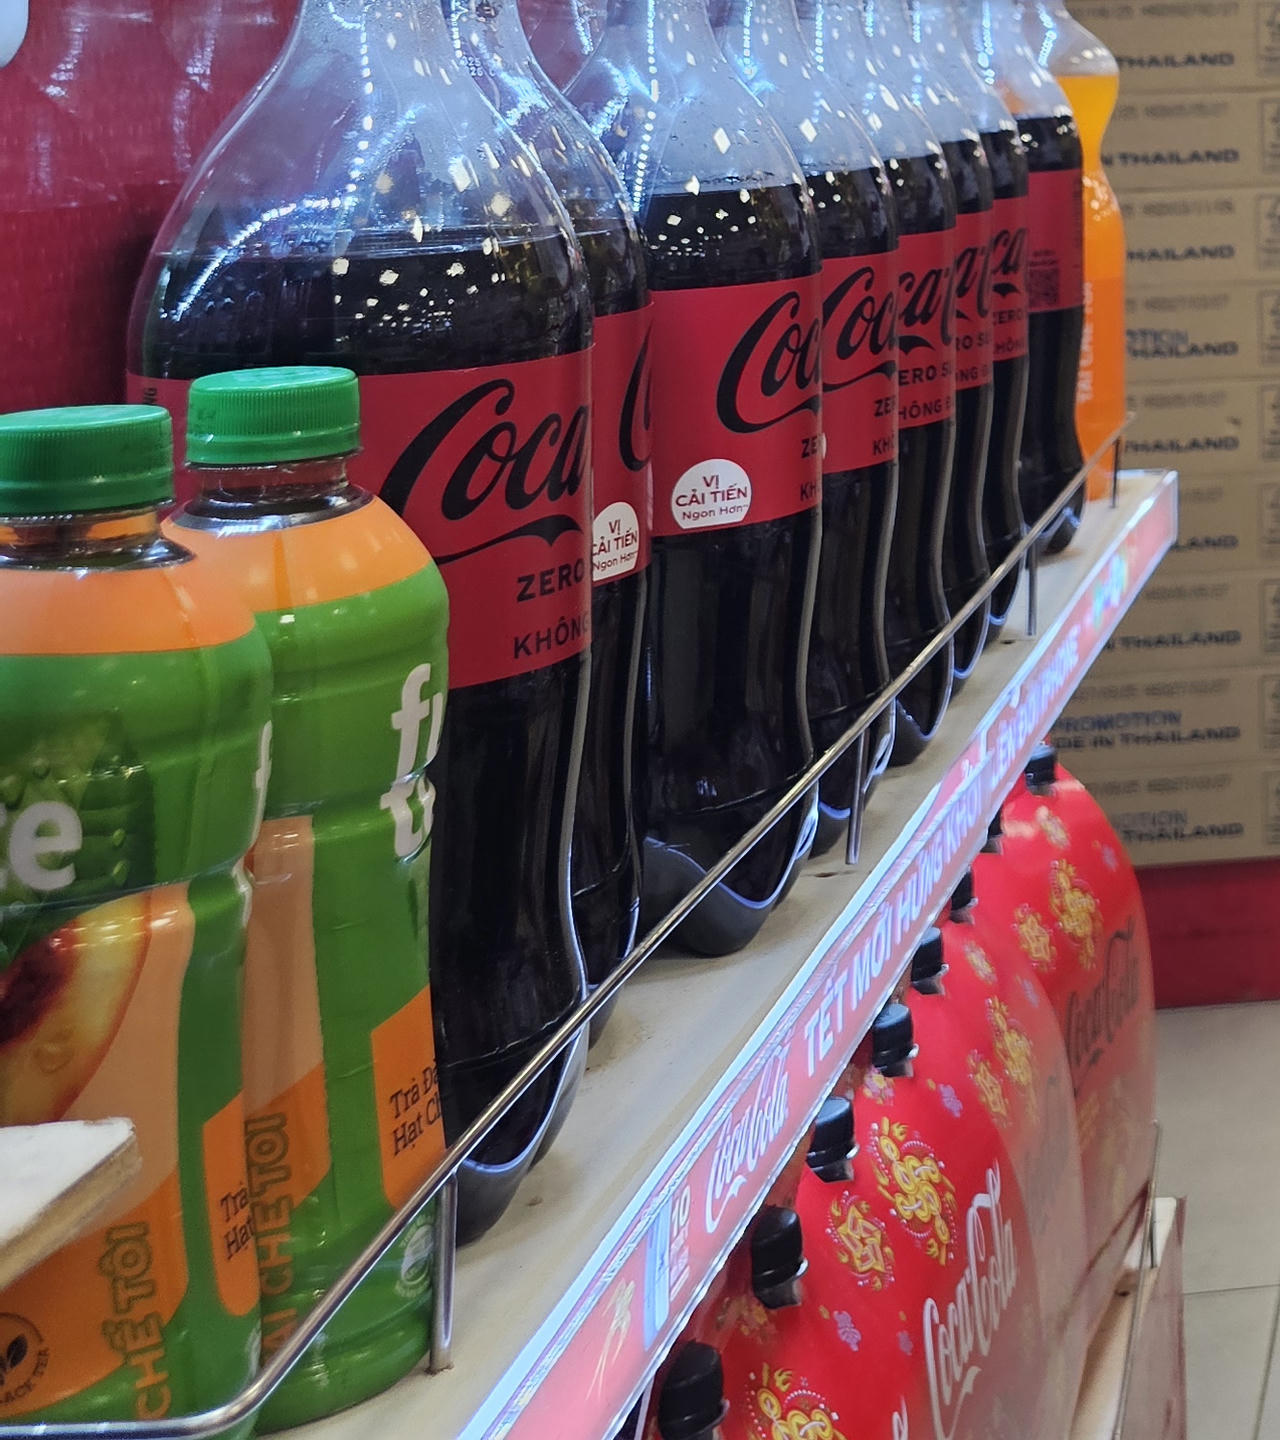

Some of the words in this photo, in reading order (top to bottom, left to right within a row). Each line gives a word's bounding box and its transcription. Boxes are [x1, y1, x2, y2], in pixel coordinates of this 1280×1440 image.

[1119, 149, 1239, 165] THAILAND
[1127, 245, 1235, 262] HAILAND
[1127, 341, 1239, 359] HAILAND
[898, 366, 937, 387] ERO
[702, 474, 720, 491] VỊ
[675, 486, 708, 509] CẢI
[709, 479, 748, 502] TIẾN
[681, 508, 716, 523] Ngon
[516, 560, 586, 603] ZERO
[1123, 629, 1241, 650] THAILAND
[1121, 726, 1241, 747] THAILAND
[804, 967, 847, 1078] TẾT
